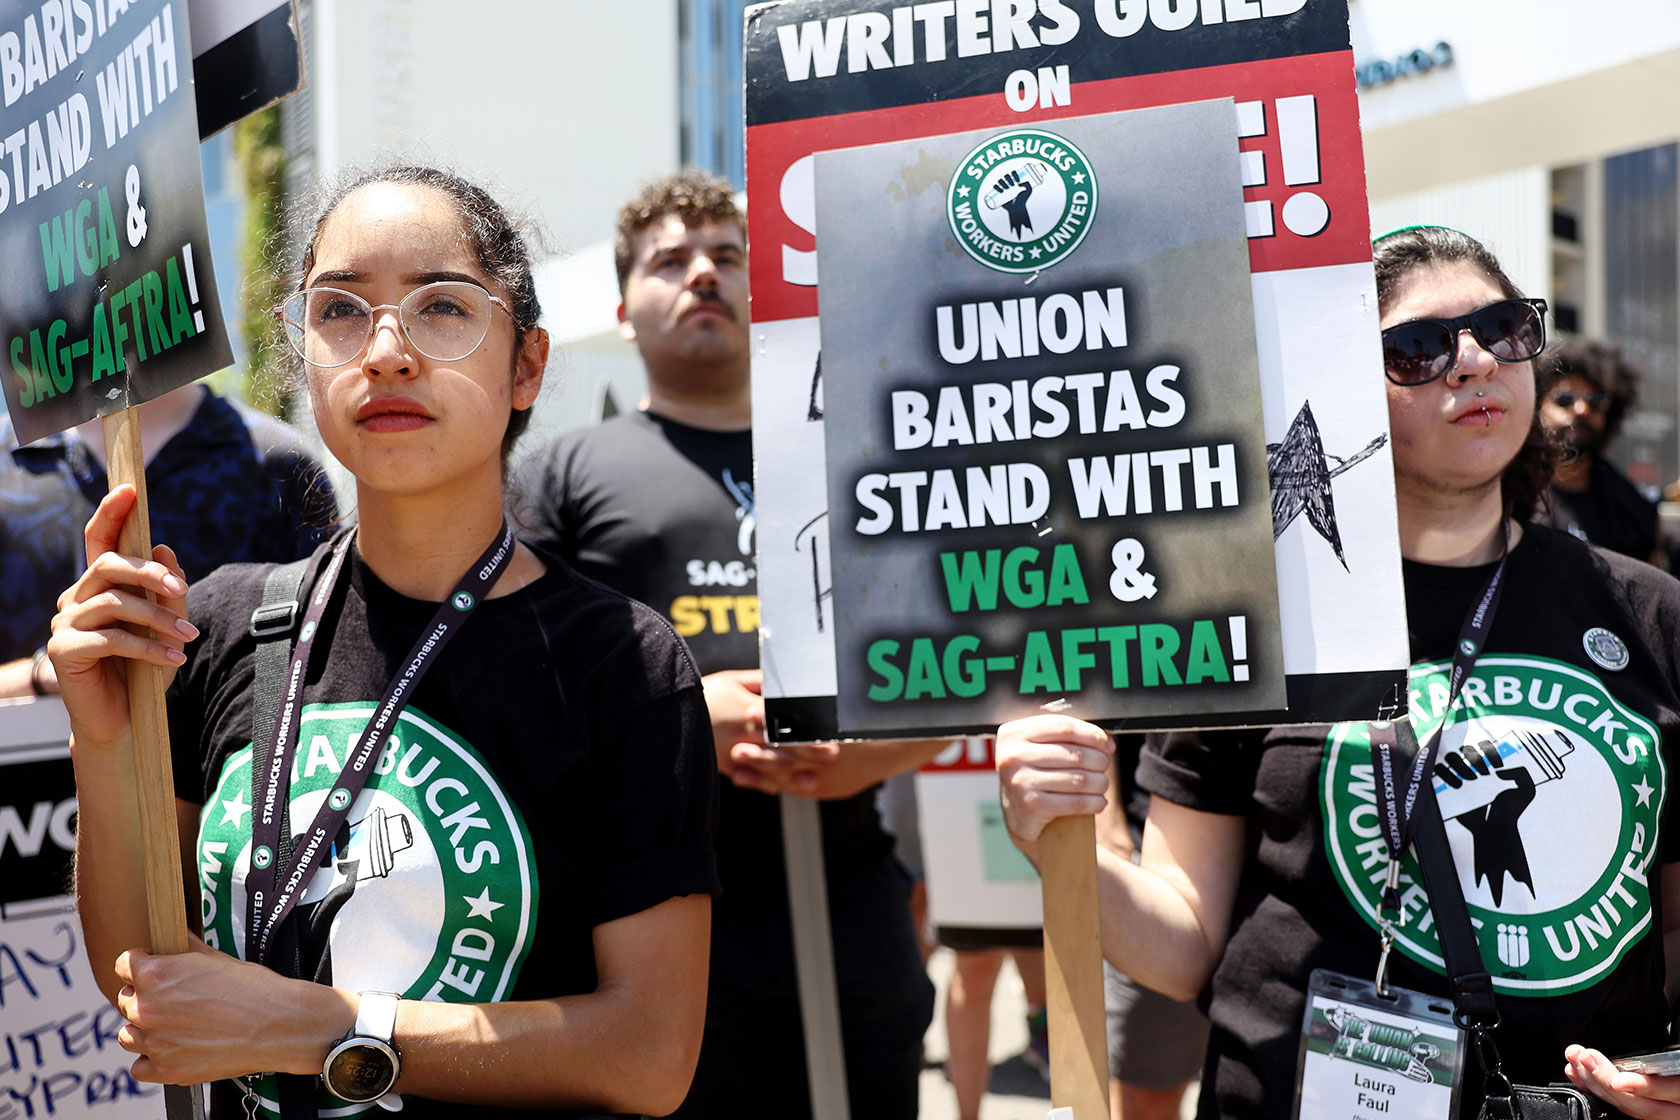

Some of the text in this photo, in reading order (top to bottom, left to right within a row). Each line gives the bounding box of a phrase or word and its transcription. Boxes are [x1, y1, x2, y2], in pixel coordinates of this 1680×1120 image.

[0, 0, 137, 107] BARIST
[96, 3, 178, 149] WITH
[776, 0, 1080, 82] WRITERS
[1004, 65, 1071, 112] ON
[967, 138, 1076, 180] STARBUCKS
[39, 164, 148, 293] WGA &
[955, 191, 1089, 262] WORKERS UNITED
[10, 243, 205, 409] SAG-AFTRA!
[936, 288, 1128, 365] UNION
[891, 365, 1186, 450] BARISTAS
[854, 444, 1240, 536] STAND WITH
[479, 547, 507, 580] UNITED
[940, 538, 1157, 613] WGA &
[353, 623, 448, 772] STARBUCKS WORKERS UNITED
[866, 616, 1250, 702] SAG-AFTRA!
[262, 659, 302, 825] STARBUCKS WORKERS UNITED
[1408, 675, 1648, 765] TARBUCKS
[290, 732, 500, 874] ABUCKS
[260, 827, 326, 950] STARBUCKS WORKERS
[1354, 1073, 1396, 1095] Laura
[1358, 1093, 1389, 1113] Faul
